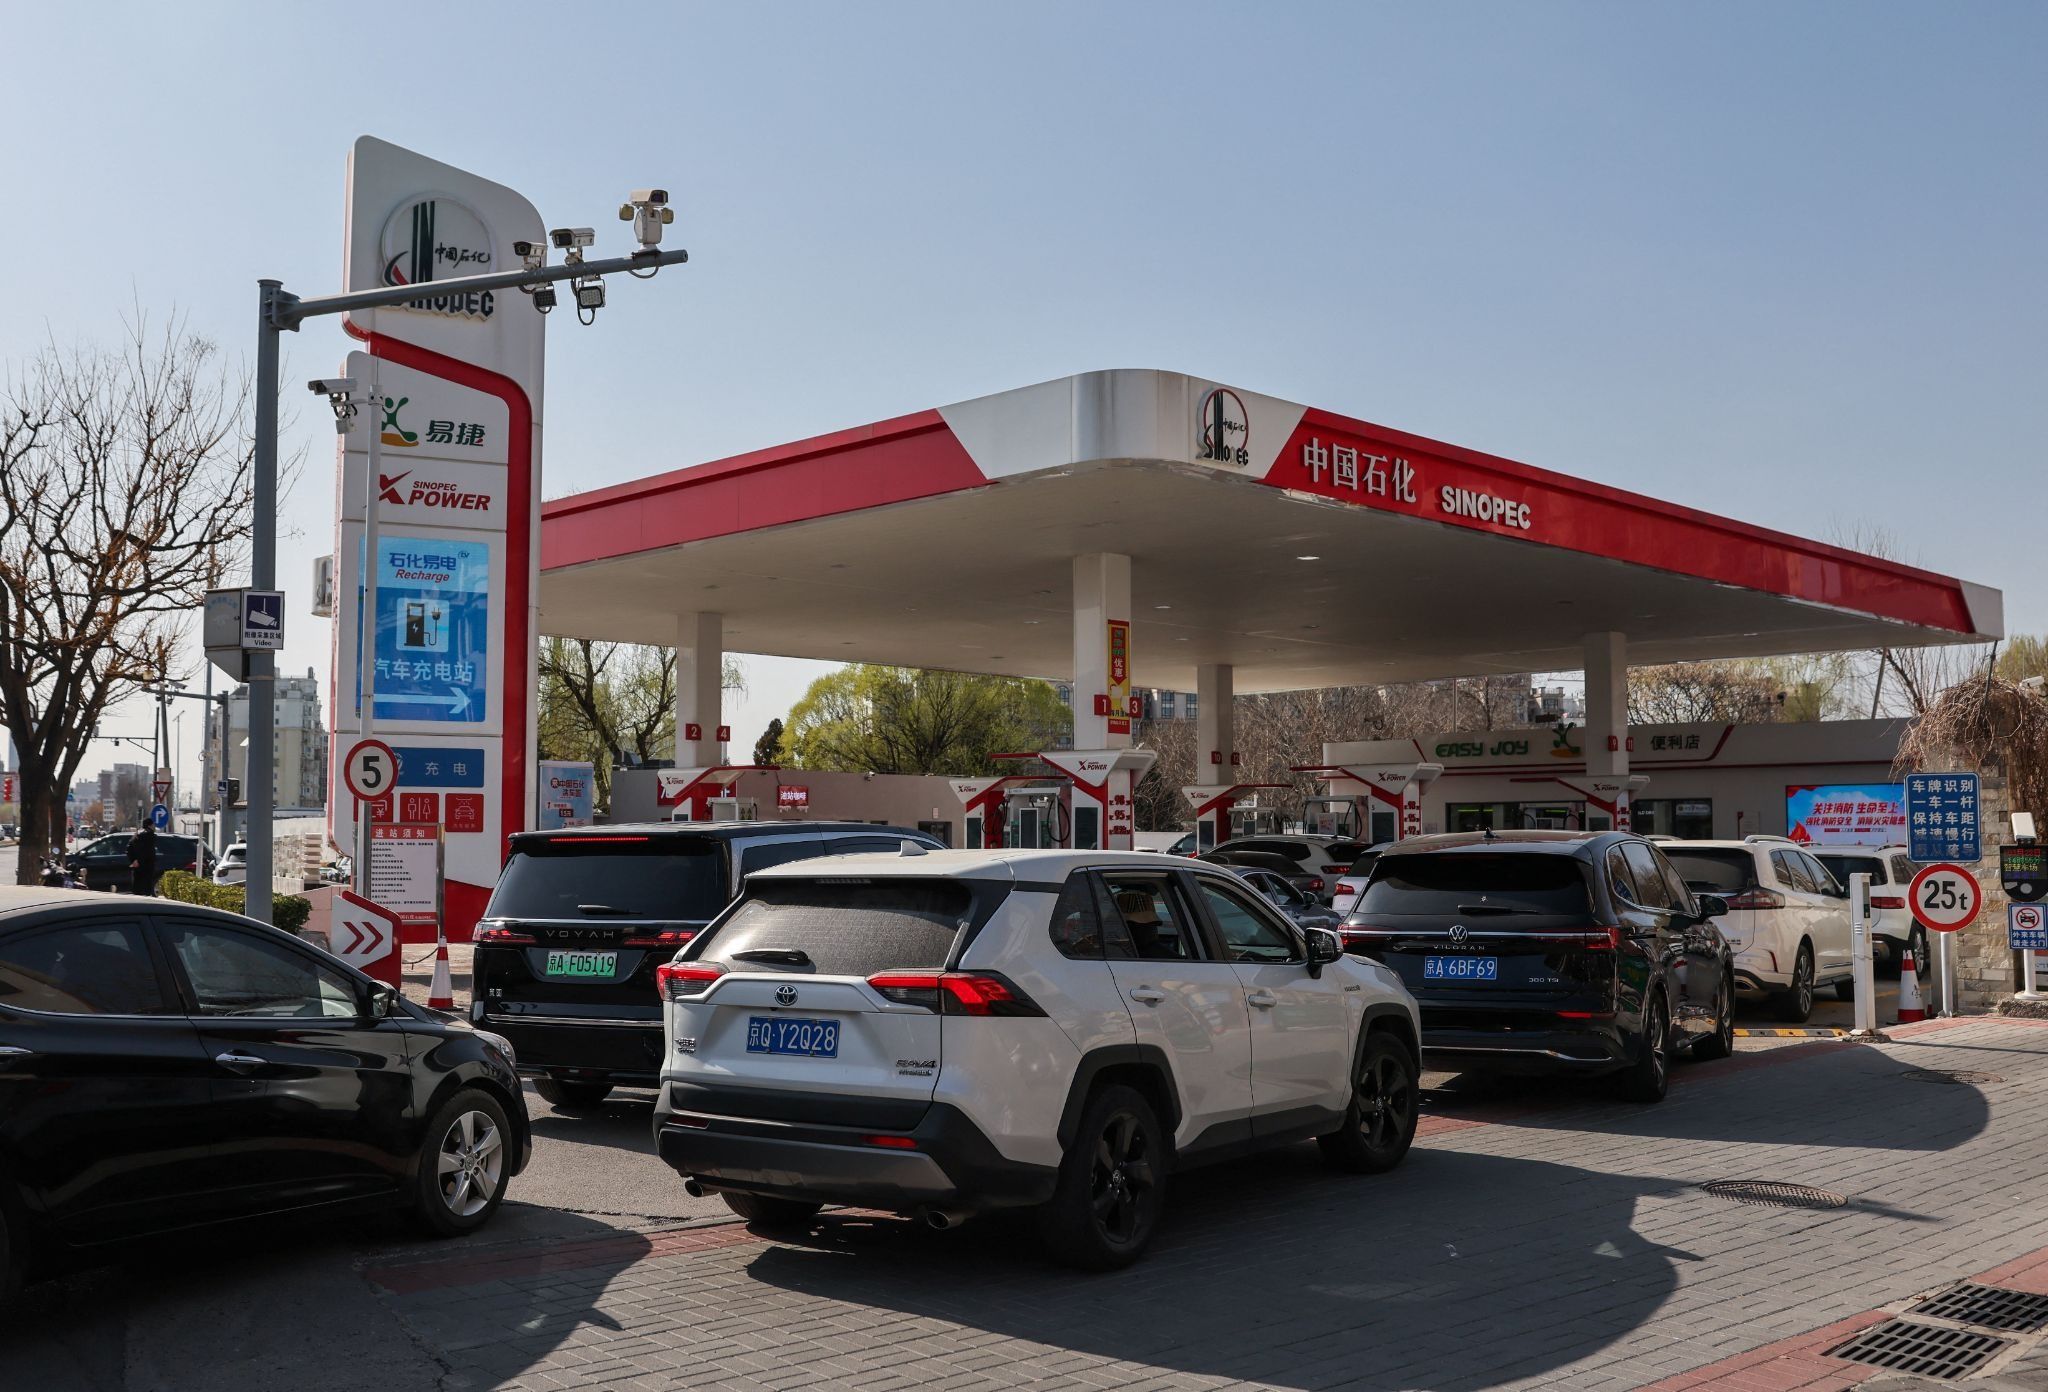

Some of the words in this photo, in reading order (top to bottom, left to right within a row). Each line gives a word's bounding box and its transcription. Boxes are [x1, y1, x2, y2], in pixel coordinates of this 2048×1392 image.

[435, 241, 491, 269] 中国石化
[426, 419, 486, 447] 易捷
[1303, 437, 1417, 504] 中国石化
[413, 480, 457, 492] SINOPEC
[1441, 485, 1532, 530] SINOPEC
[389, 552, 457, 570] 石化易电
[395, 569, 450, 583] Recharge
[1102, 699, 1107, 712] 1
[1132, 700, 1138, 714] 3
[691, 726, 697, 737] 2
[720, 730, 727, 739] 4
[1436, 742, 1484, 757] EASY
[1490, 740, 1529, 756] JOY
[1650, 735, 1700, 750] 便利店
[361, 755, 382, 789] 5
[425, 762, 467, 776] 充电
[1912, 780, 1974, 793] 车牌识别
[1813, 803, 1854, 814] 关注消防
[1856, 802, 1898, 814] 生命至上
[1913, 796, 1975, 809] 一车一杆
[1913, 812, 1975, 826] 保持车距
[376, 829, 425, 838] 进站须知
[1914, 828, 1976, 842] 减速慢行
[546, 930, 614, 939] VOYAH
